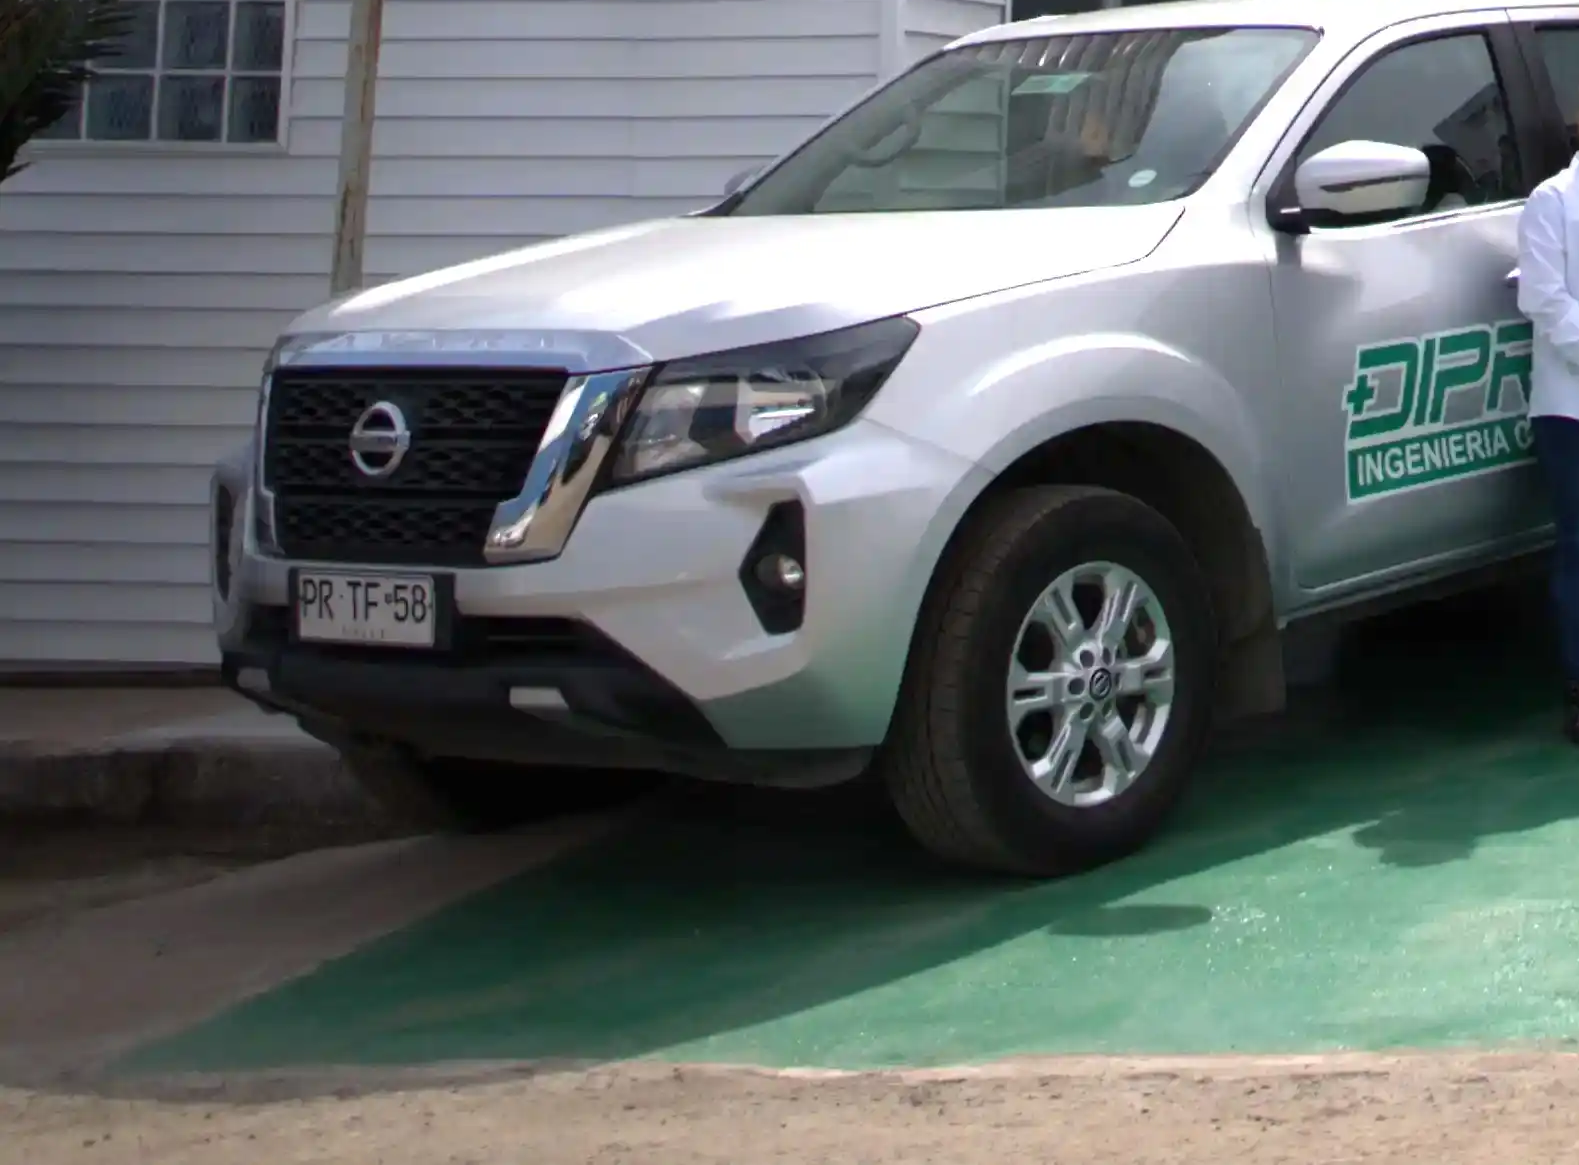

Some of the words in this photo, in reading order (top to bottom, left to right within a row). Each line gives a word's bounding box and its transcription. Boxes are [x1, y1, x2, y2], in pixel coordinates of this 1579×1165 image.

[1357, 424, 1511, 486] INGENIERIA
[302, 579, 334, 620] PR
[346, 580, 381, 622] TF
[394, 584, 427, 623] 58
